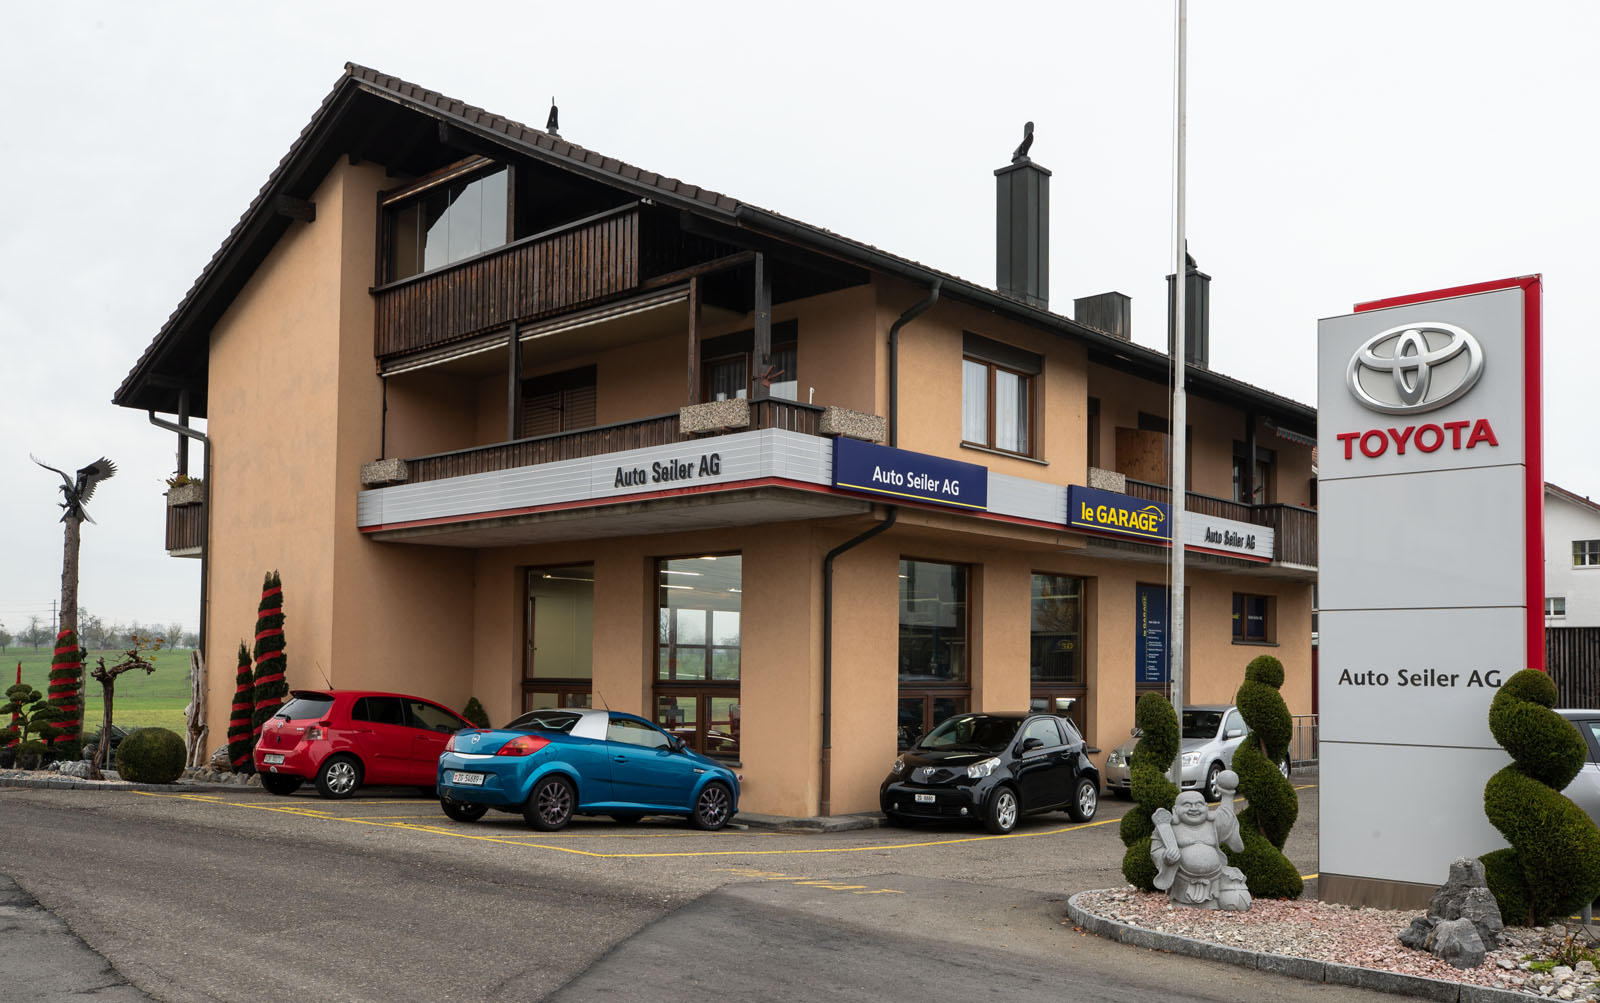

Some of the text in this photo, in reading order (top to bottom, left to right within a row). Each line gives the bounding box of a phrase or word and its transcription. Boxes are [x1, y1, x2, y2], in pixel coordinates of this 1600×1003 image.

[1337, 419, 1499, 460] TOYOTA
[615, 453, 721, 488] Auto Seiler AG
[872, 466, 959, 496] Auto Seiler AG
[1081, 502, 1158, 532] le GARAGE
[1204, 527, 1256, 550] Auto Seiler AG
[1338, 669, 1502, 688] Auto Seiler AG
